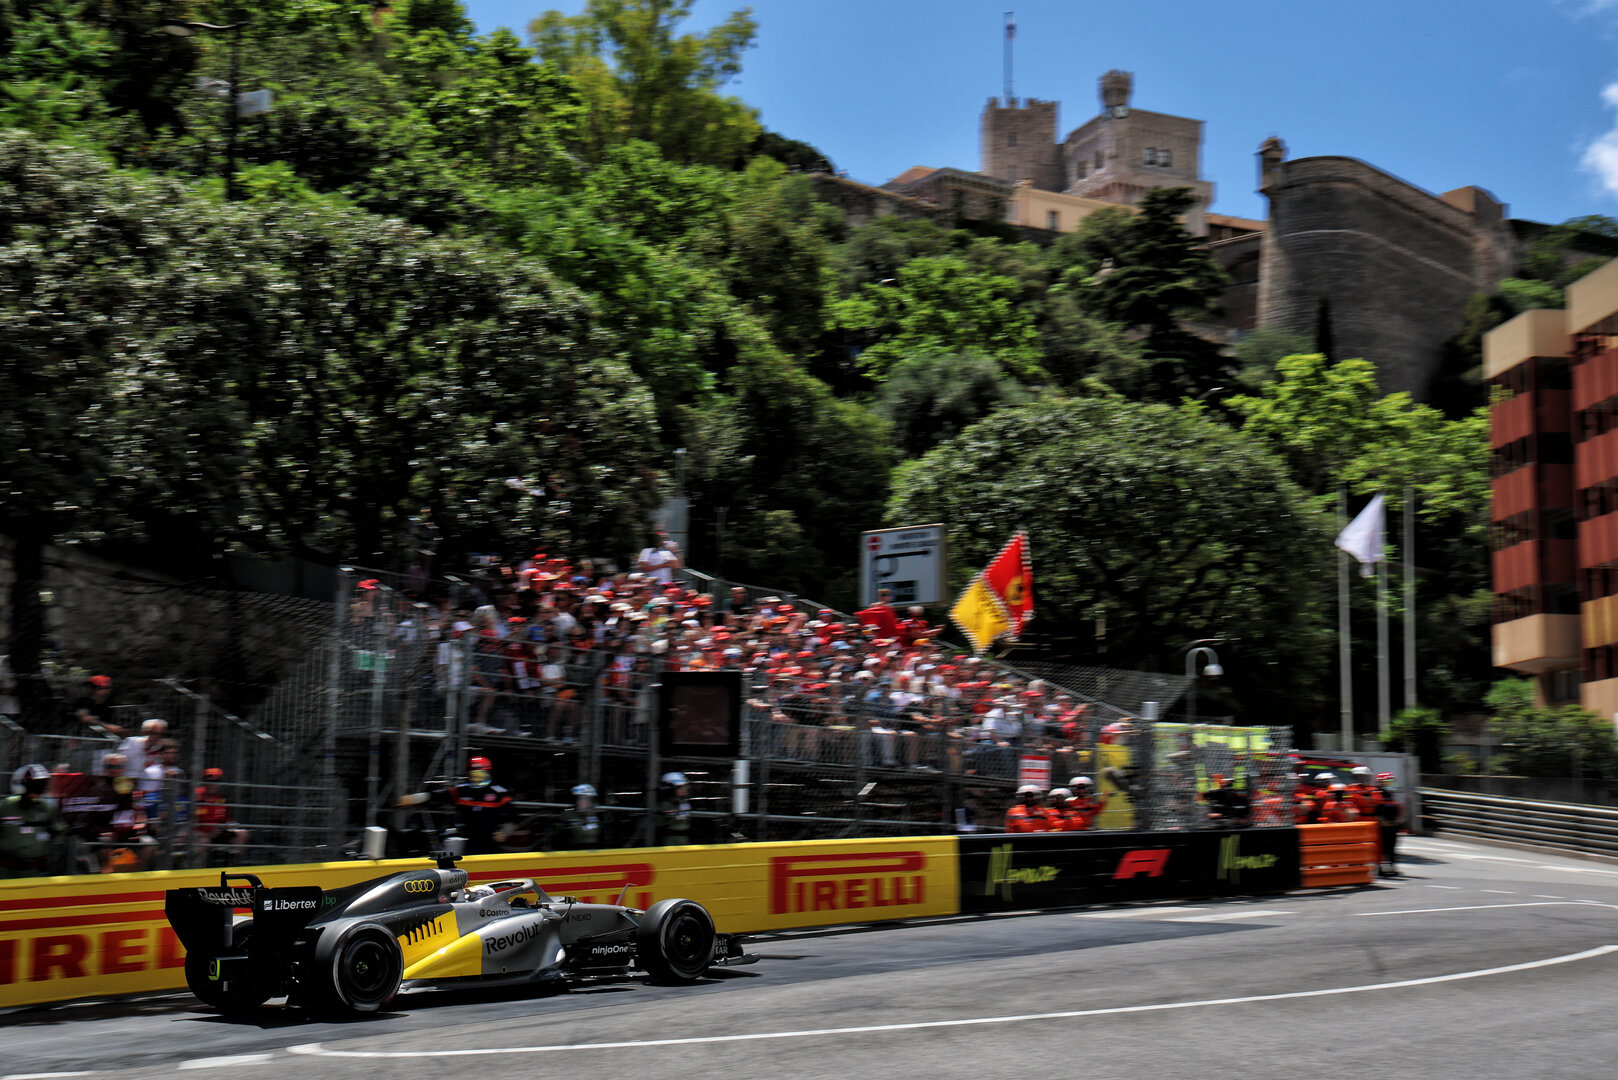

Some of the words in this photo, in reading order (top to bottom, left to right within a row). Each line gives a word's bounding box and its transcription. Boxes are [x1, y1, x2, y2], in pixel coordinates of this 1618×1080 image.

[769, 851, 927, 914] PIRELLI
[274, 899, 317, 911] Libertex
[325, 896, 337, 906] bp
[484, 921, 539, 955] Revolut
[592, 945, 629, 956] ninjaOne
